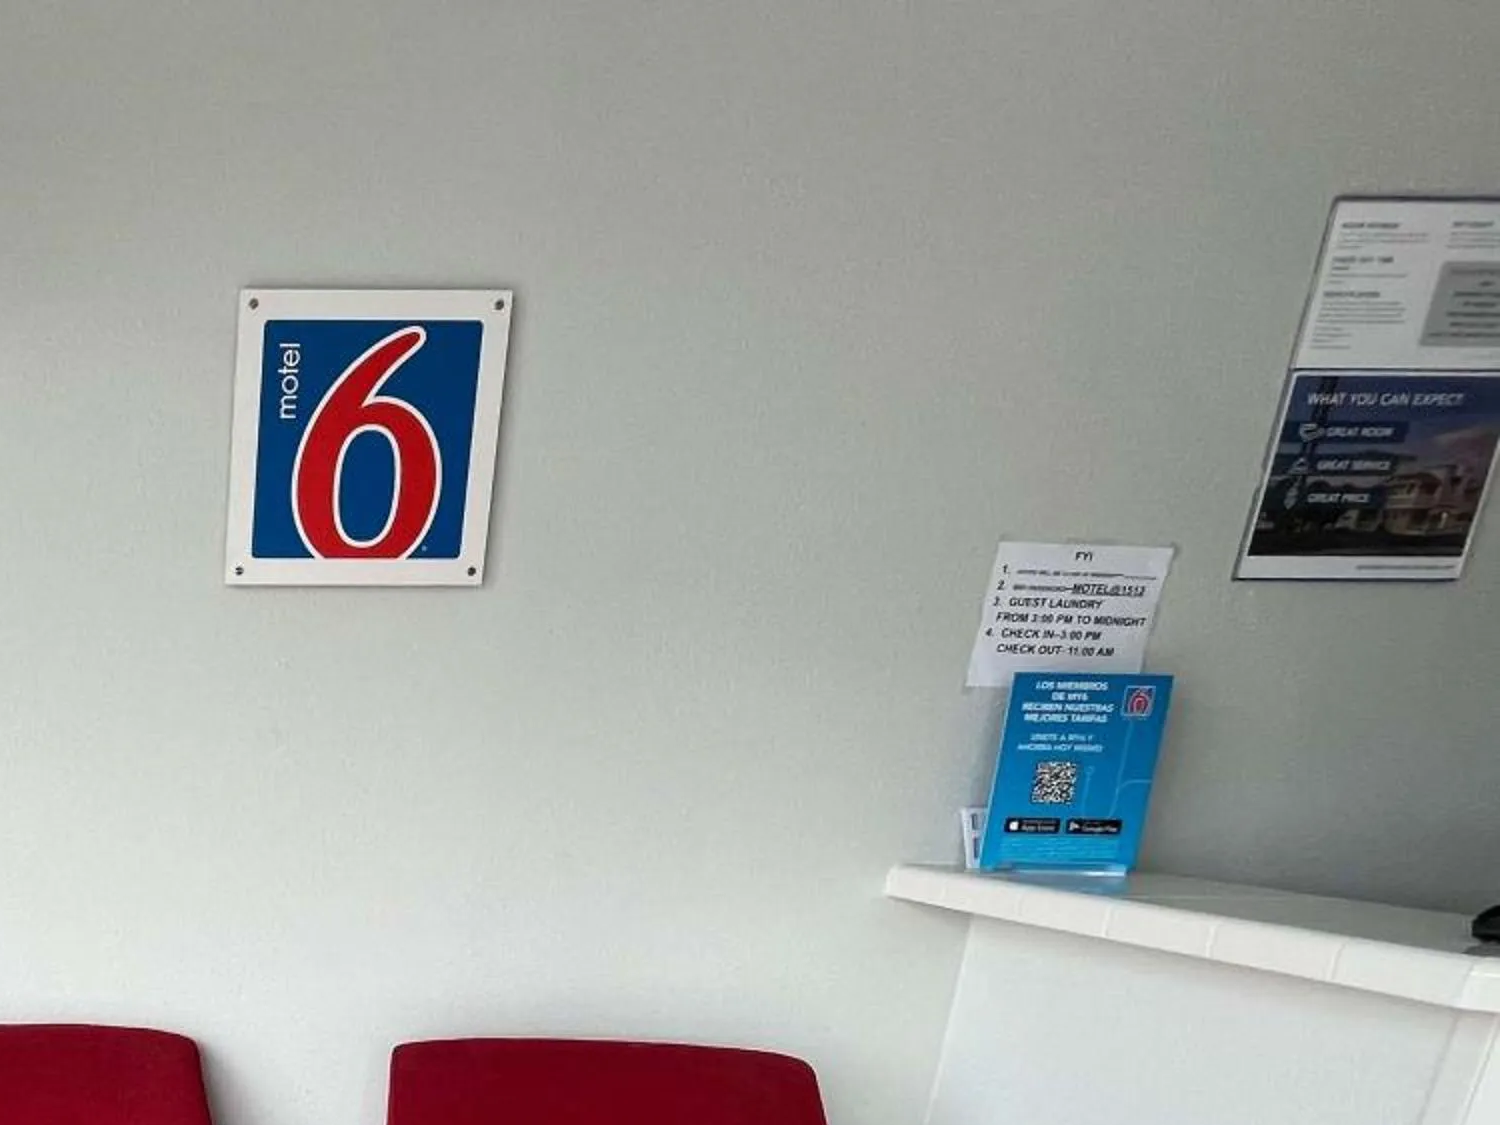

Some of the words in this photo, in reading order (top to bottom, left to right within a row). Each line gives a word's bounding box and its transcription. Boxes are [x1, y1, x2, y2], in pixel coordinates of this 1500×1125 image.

[277, 343, 301, 419] motel
[1307, 392, 1347, 405] WHAT
[1350, 392, 1379, 405] YOU
[1380, 392, 1410, 406] CAN
[1411, 393, 1465, 406] EXPECT
[291, 325, 442, 559] 6
[1009, 597, 1047, 608] GUEST
[1048, 598, 1103, 609] LAUNDRY
[996, 612, 1029, 623] FROM
[1056, 614, 1073, 624] PM
[1077, 615, 1092, 625] TO
[1093, 616, 1147, 627] MIDNIGHT
[1001, 628, 1040, 638] CHECK
[1084, 631, 1102, 641] PM
[996, 643, 1037, 655] CHECK
[1096, 647, 1115, 657] AM
[1036, 681, 1055, 690] LOS
